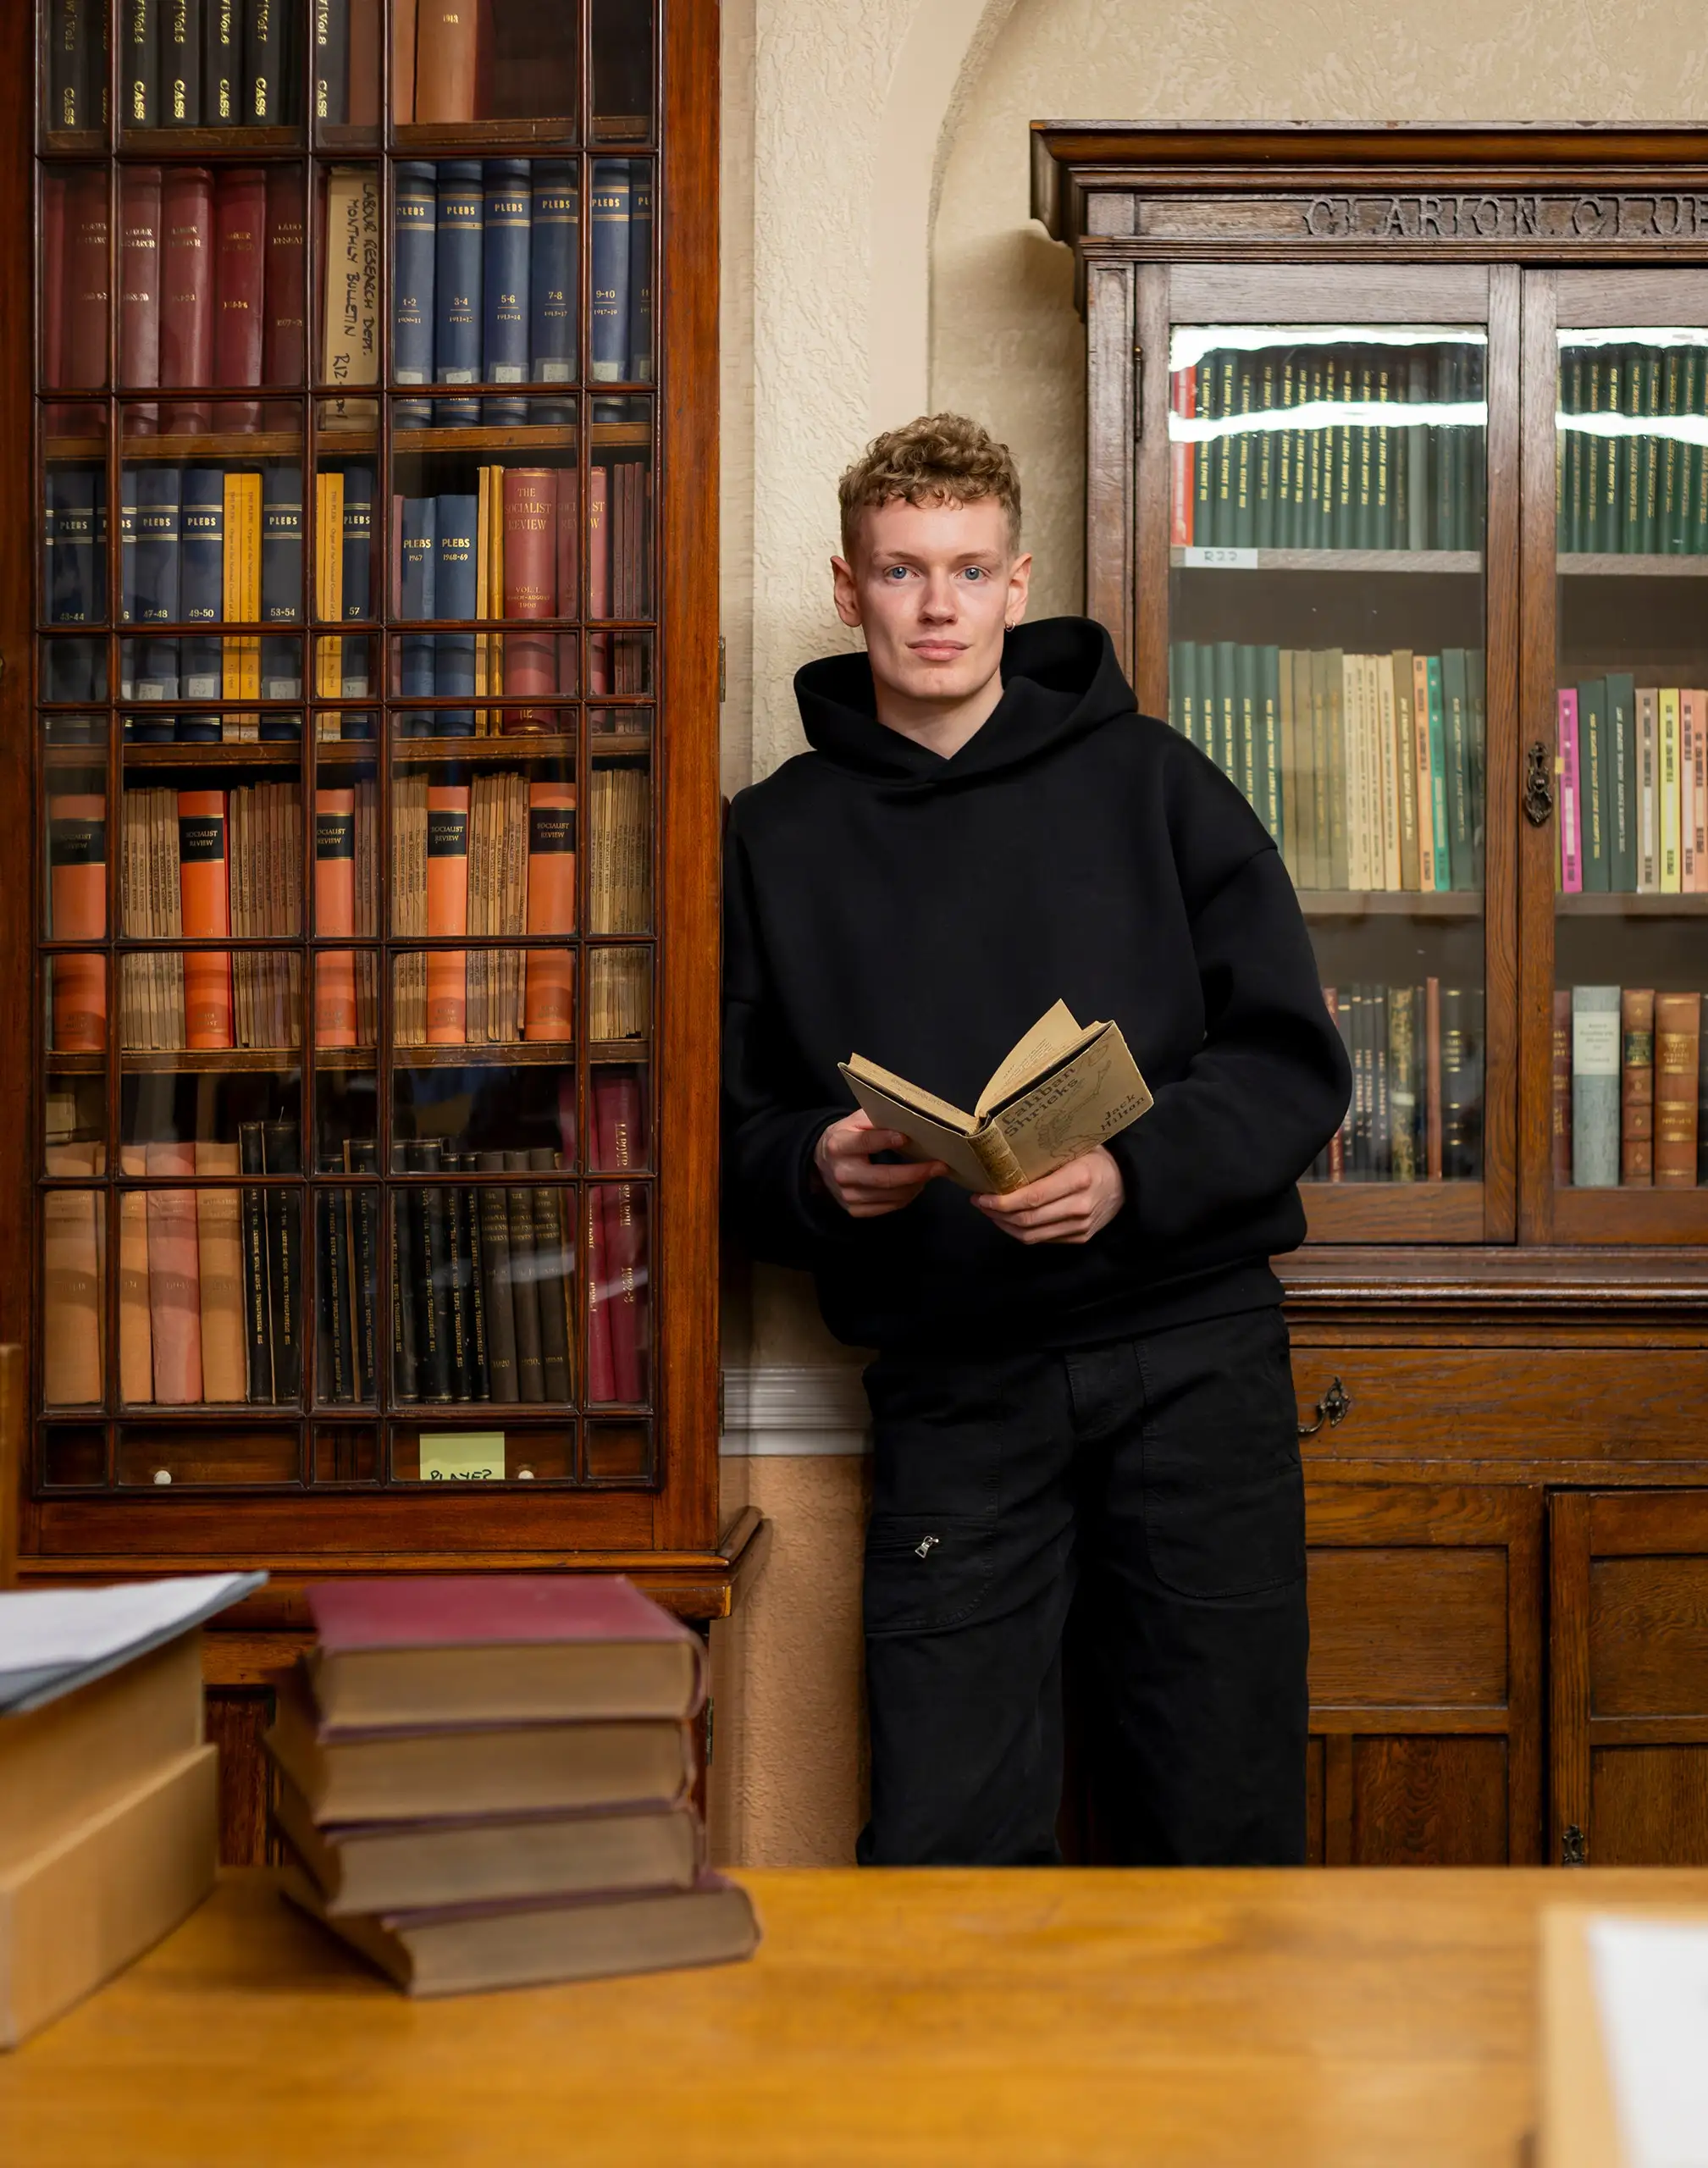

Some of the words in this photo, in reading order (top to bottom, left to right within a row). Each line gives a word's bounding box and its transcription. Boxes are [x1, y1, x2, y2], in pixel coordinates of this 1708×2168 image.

[134, 80, 146, 120] CASS
[174, 80, 185, 119] CASS
[219, 78, 230, 118] CASS
[256, 78, 266, 116] CASS
[318, 80, 328, 118] CASS
[64, 87, 75, 125] CASS
[542, 200, 571, 209] PLEBS
[592, 197, 621, 207] PLEBS
[363, 183, 378, 234] LABOUR
[395, 207, 425, 217] PLEBS
[446, 206, 476, 216] PLEBS
[495, 202, 523, 213] PLEBS
[346, 198, 360, 263] MONTHLY
[362, 239, 378, 310] RESEARCH
[500, 294, 516, 304] 5-6
[548, 290, 563, 300] 7-8
[595, 290, 616, 299] 9-10
[344, 272, 361, 338] BULLETIN
[454, 297, 468, 306] 3-4
[517, 487, 536, 497] THE
[504, 501, 552, 514] SOCIALIST
[143, 517, 171, 528] PLEBS
[187, 517, 217, 527] PLEBS
[269, 516, 298, 526] PLEBS
[344, 515, 371, 525] PLEBS
[508, 518, 546, 531] REVIEW
[59, 520, 88, 531] PLEBS
[403, 538, 432, 549] PLEBS
[441, 538, 471, 549] PLEBS
[442, 553, 468, 561] 1968-69
[143, 610, 168, 619] 47-48
[189, 609, 214, 618] 49-50
[270, 608, 296, 617] 53-54
[348, 607, 360, 617] 57
[430, 825, 464, 833] SOCIALIST
[536, 822, 569, 831] SOCIALIST
[185, 830, 218, 838] SOCIALIST
[434, 834, 460, 843] REVIEW
[540, 831, 565, 839] REVIEW
[189, 838, 214, 847] REVIEW
[1002, 1066, 1076, 1125] Caliban
[1003, 1078, 1078, 1137] Shrieks
[1104, 1093, 1136, 1120] Jack
[1101, 1097, 1145, 1131] Hilton
[615, 1123, 627, 1166] LABOUR
